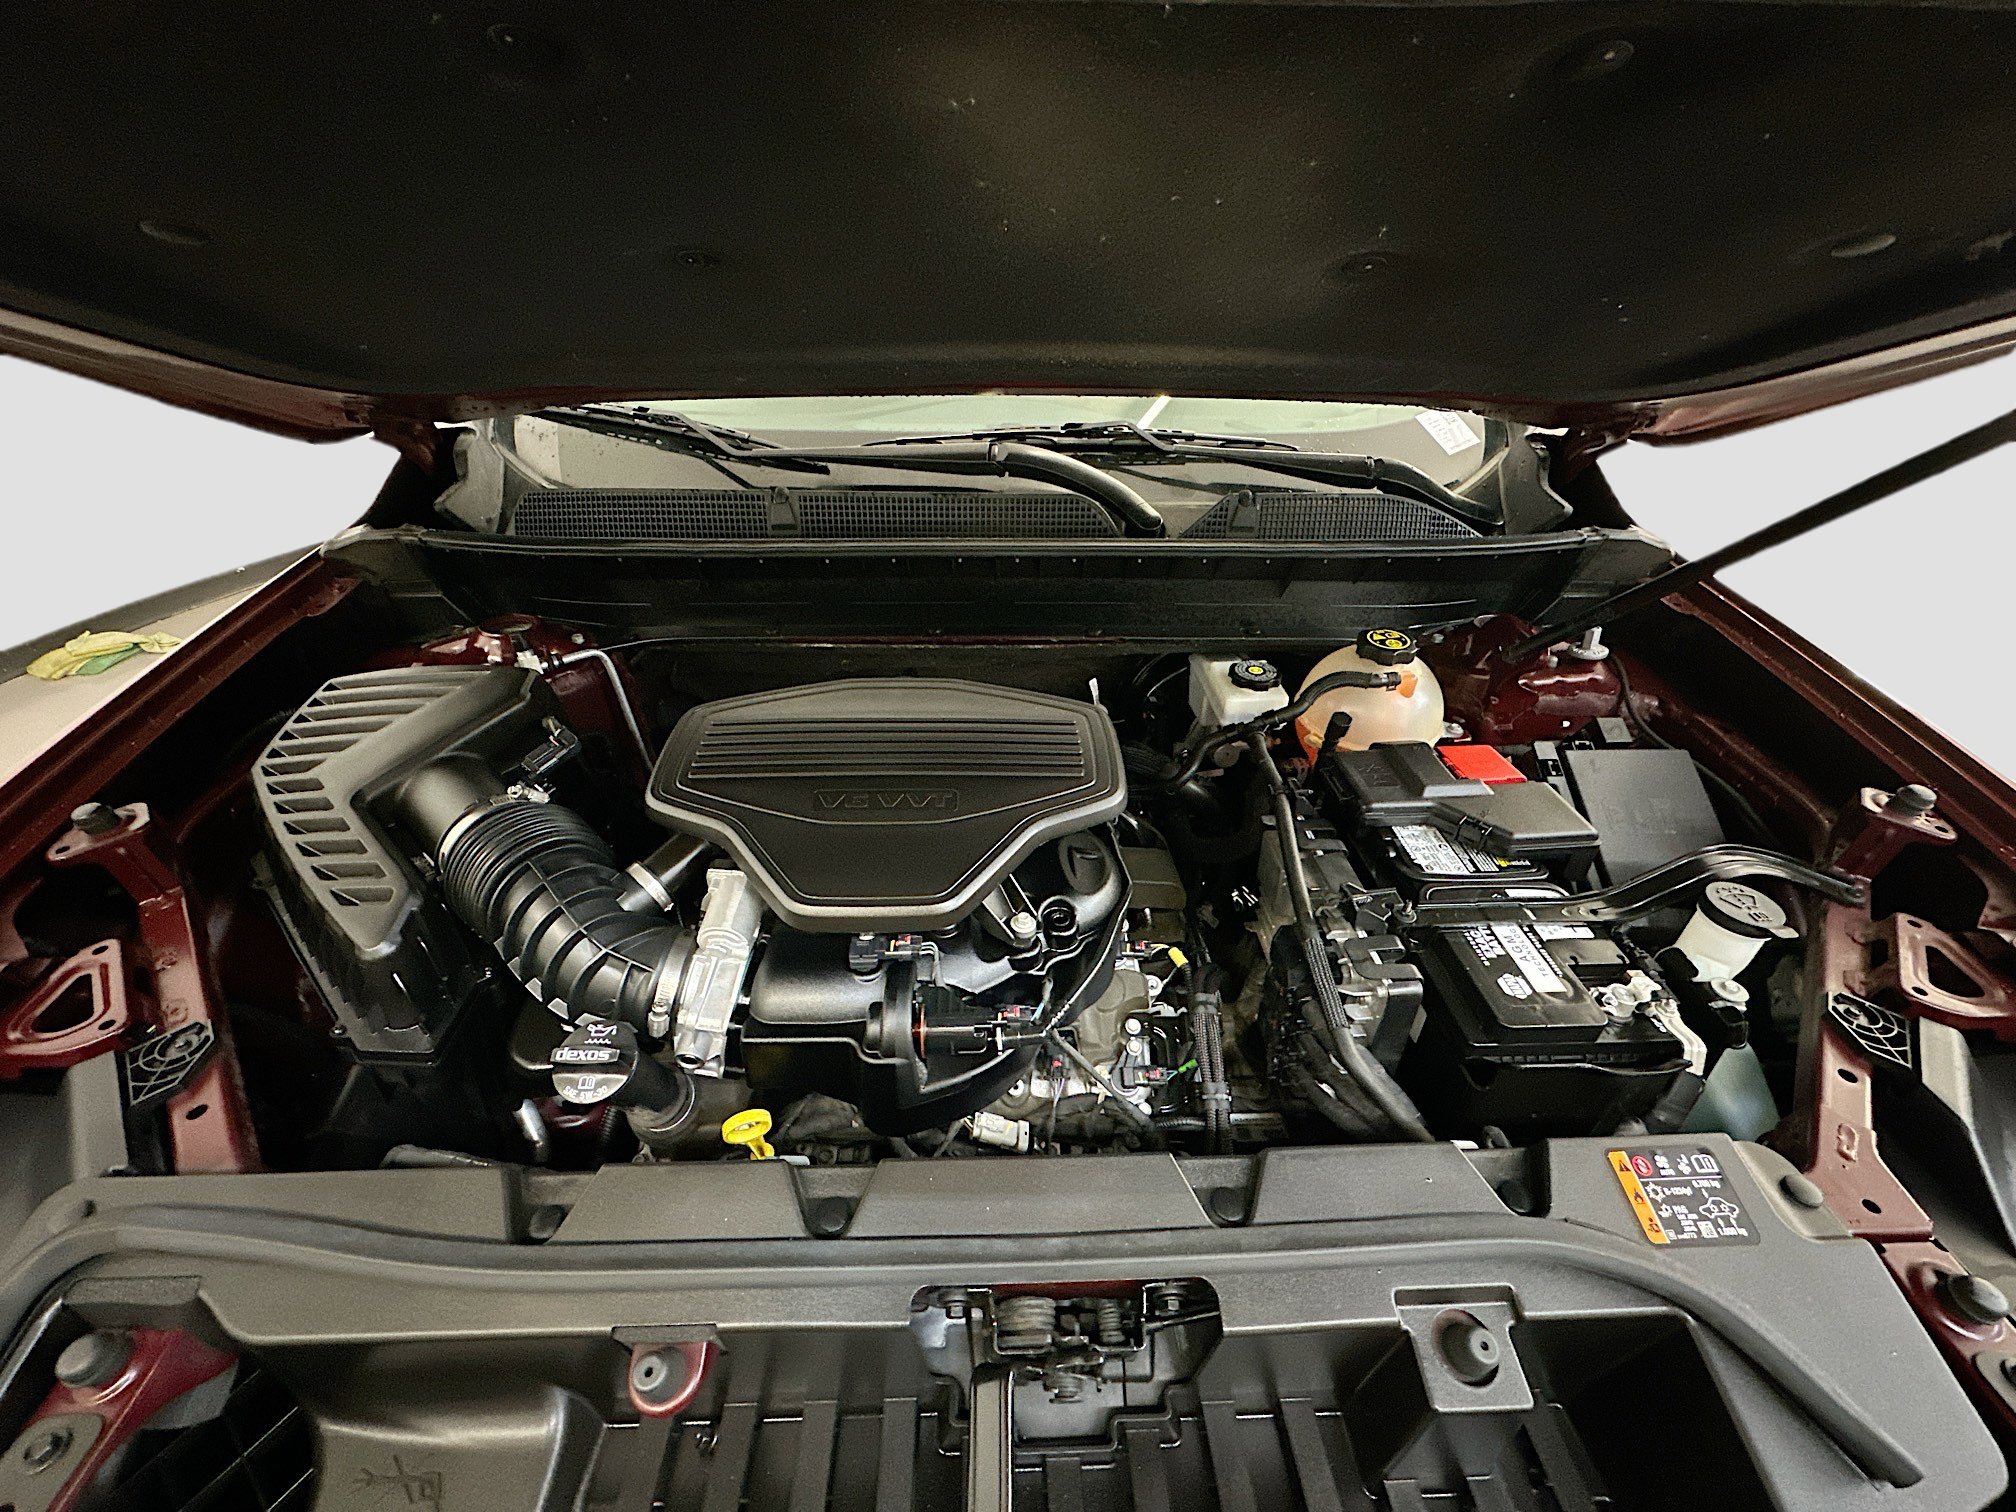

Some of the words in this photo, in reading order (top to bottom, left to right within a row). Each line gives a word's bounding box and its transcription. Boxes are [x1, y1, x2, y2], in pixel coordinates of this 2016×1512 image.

[877, 793, 953, 808] VVT
[1503, 934, 1531, 962] AGM
[555, 1046, 612, 1061] dexos
[563, 1085, 578, 1099] SAE
[579, 1085, 608, 1100] 5W-30
